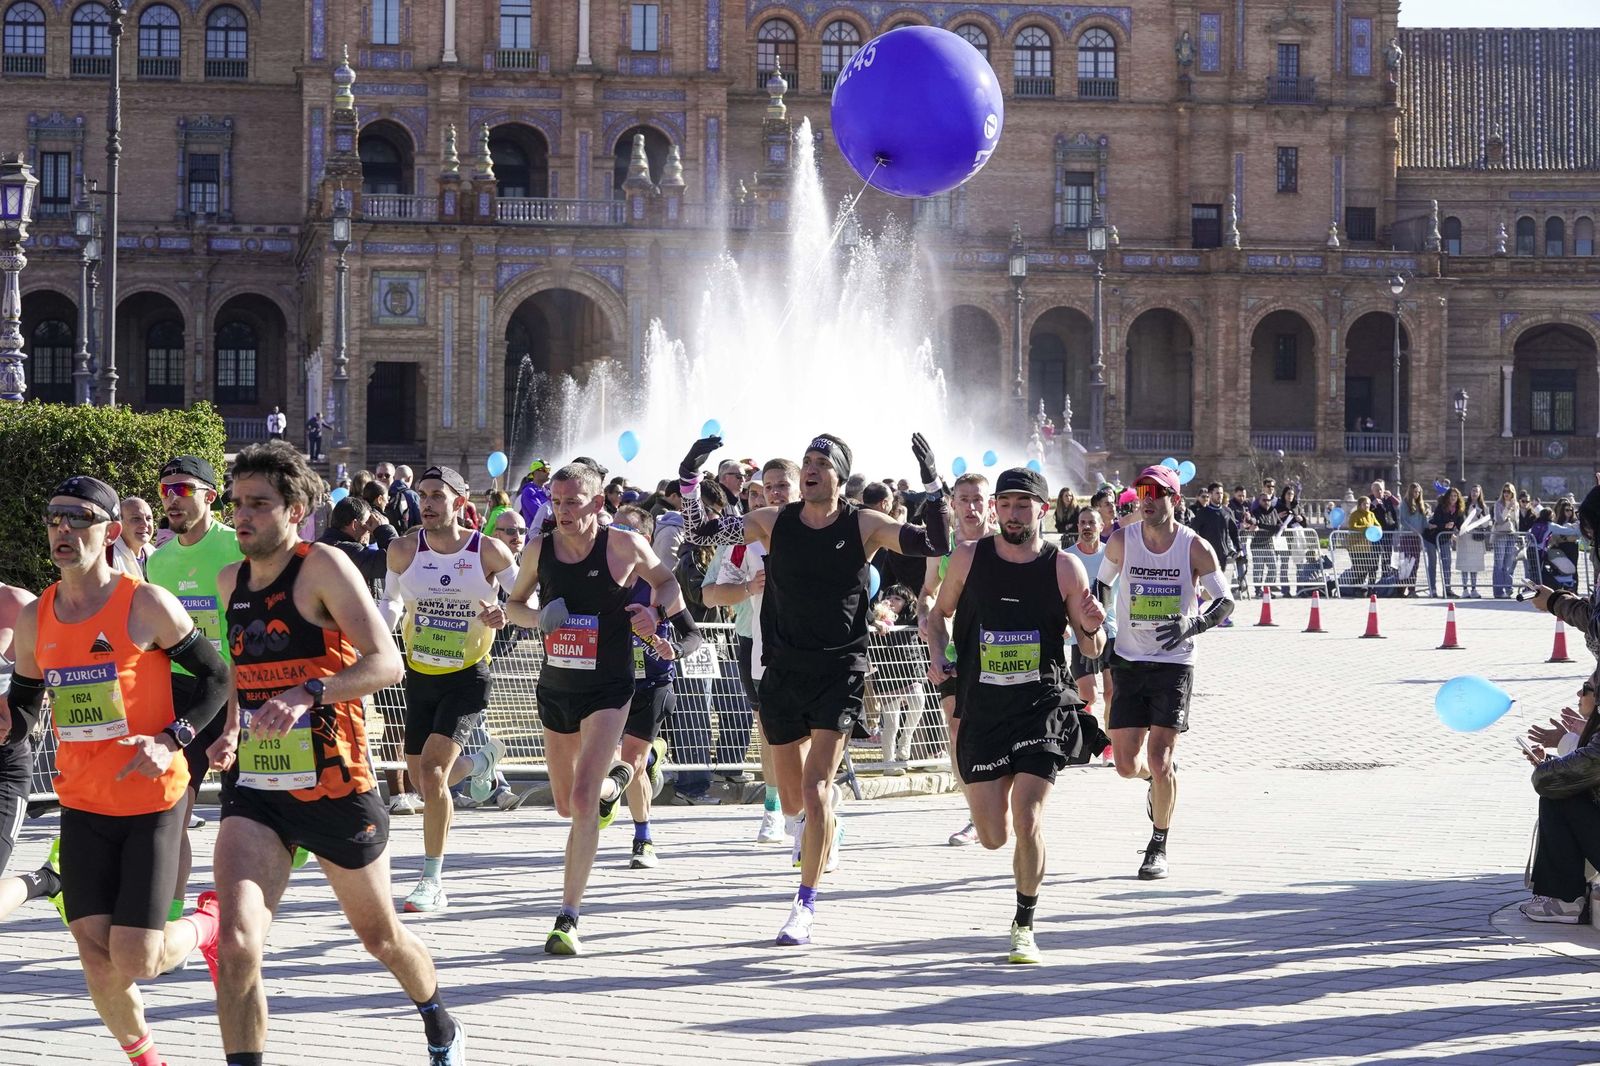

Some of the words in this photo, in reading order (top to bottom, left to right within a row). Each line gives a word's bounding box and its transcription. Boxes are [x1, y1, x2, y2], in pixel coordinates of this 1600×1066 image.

[1130, 566, 1180, 577] MONSANTO
[1147, 586, 1176, 594] ZURICH
[182, 599, 211, 608] ZURICH
[418, 601, 445, 609] SANTA
[427, 608, 477, 618] APÓSTOLES
[432, 619, 462, 629] ZURICH
[563, 617, 592, 626] URICH
[432, 633, 446, 642] 1841
[559, 633, 576, 642] 1473
[998, 634, 1033, 642] ZURICH
[552, 643, 583, 656] BRIAN
[1000, 650, 1018, 658] 1802
[988, 660, 1032, 672] REANEY
[65, 668, 108, 682] ZURICH
[71, 692, 92, 704] 1624
[68, 707, 103, 724] JOAN
[259, 739, 281, 750] 2113
[254, 754, 291, 771] FRUN
